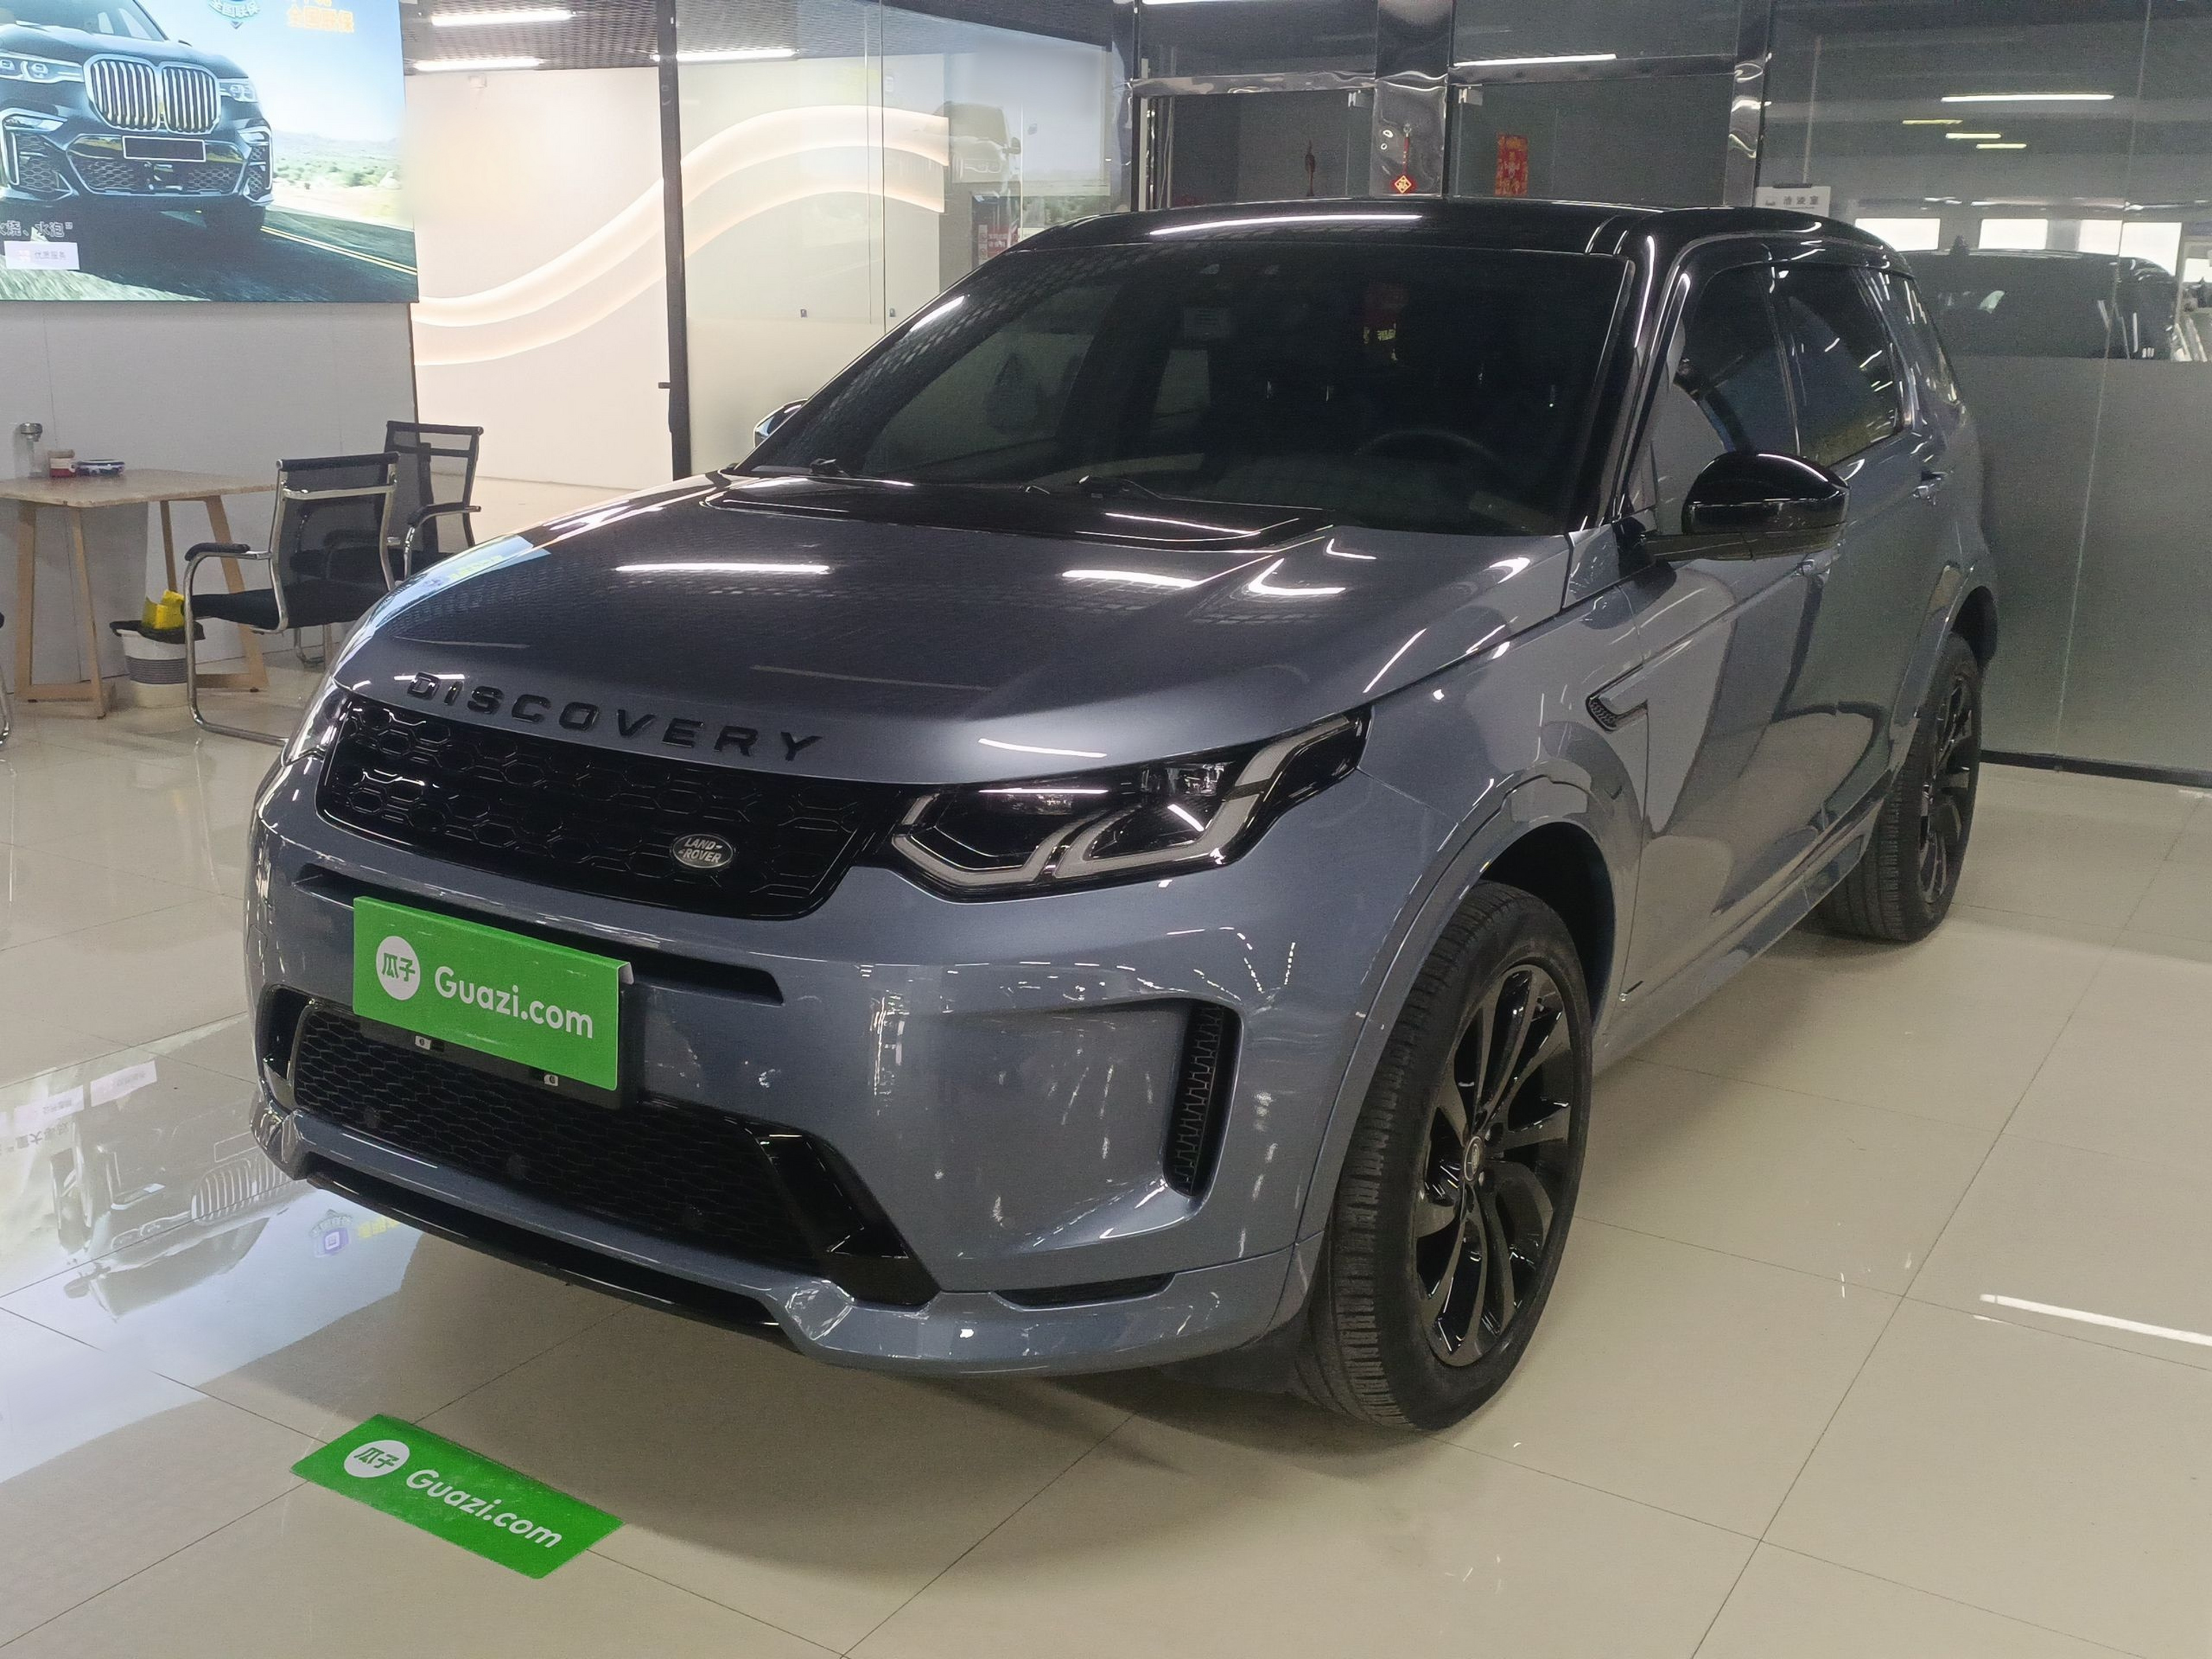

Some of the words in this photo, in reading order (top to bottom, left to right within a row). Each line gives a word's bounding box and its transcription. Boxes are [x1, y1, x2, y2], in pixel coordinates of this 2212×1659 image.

[407, 671, 823, 762] DISCOVERY
[683, 848, 722, 863] ROVER
[684, 838, 716, 850] LAND
[382, 952, 415, 982] 瓜子
[435, 966, 593, 1039] Guazi.com
[353, 1447, 400, 1469] 瓜子
[406, 1469, 563, 1548] Guazi.com
